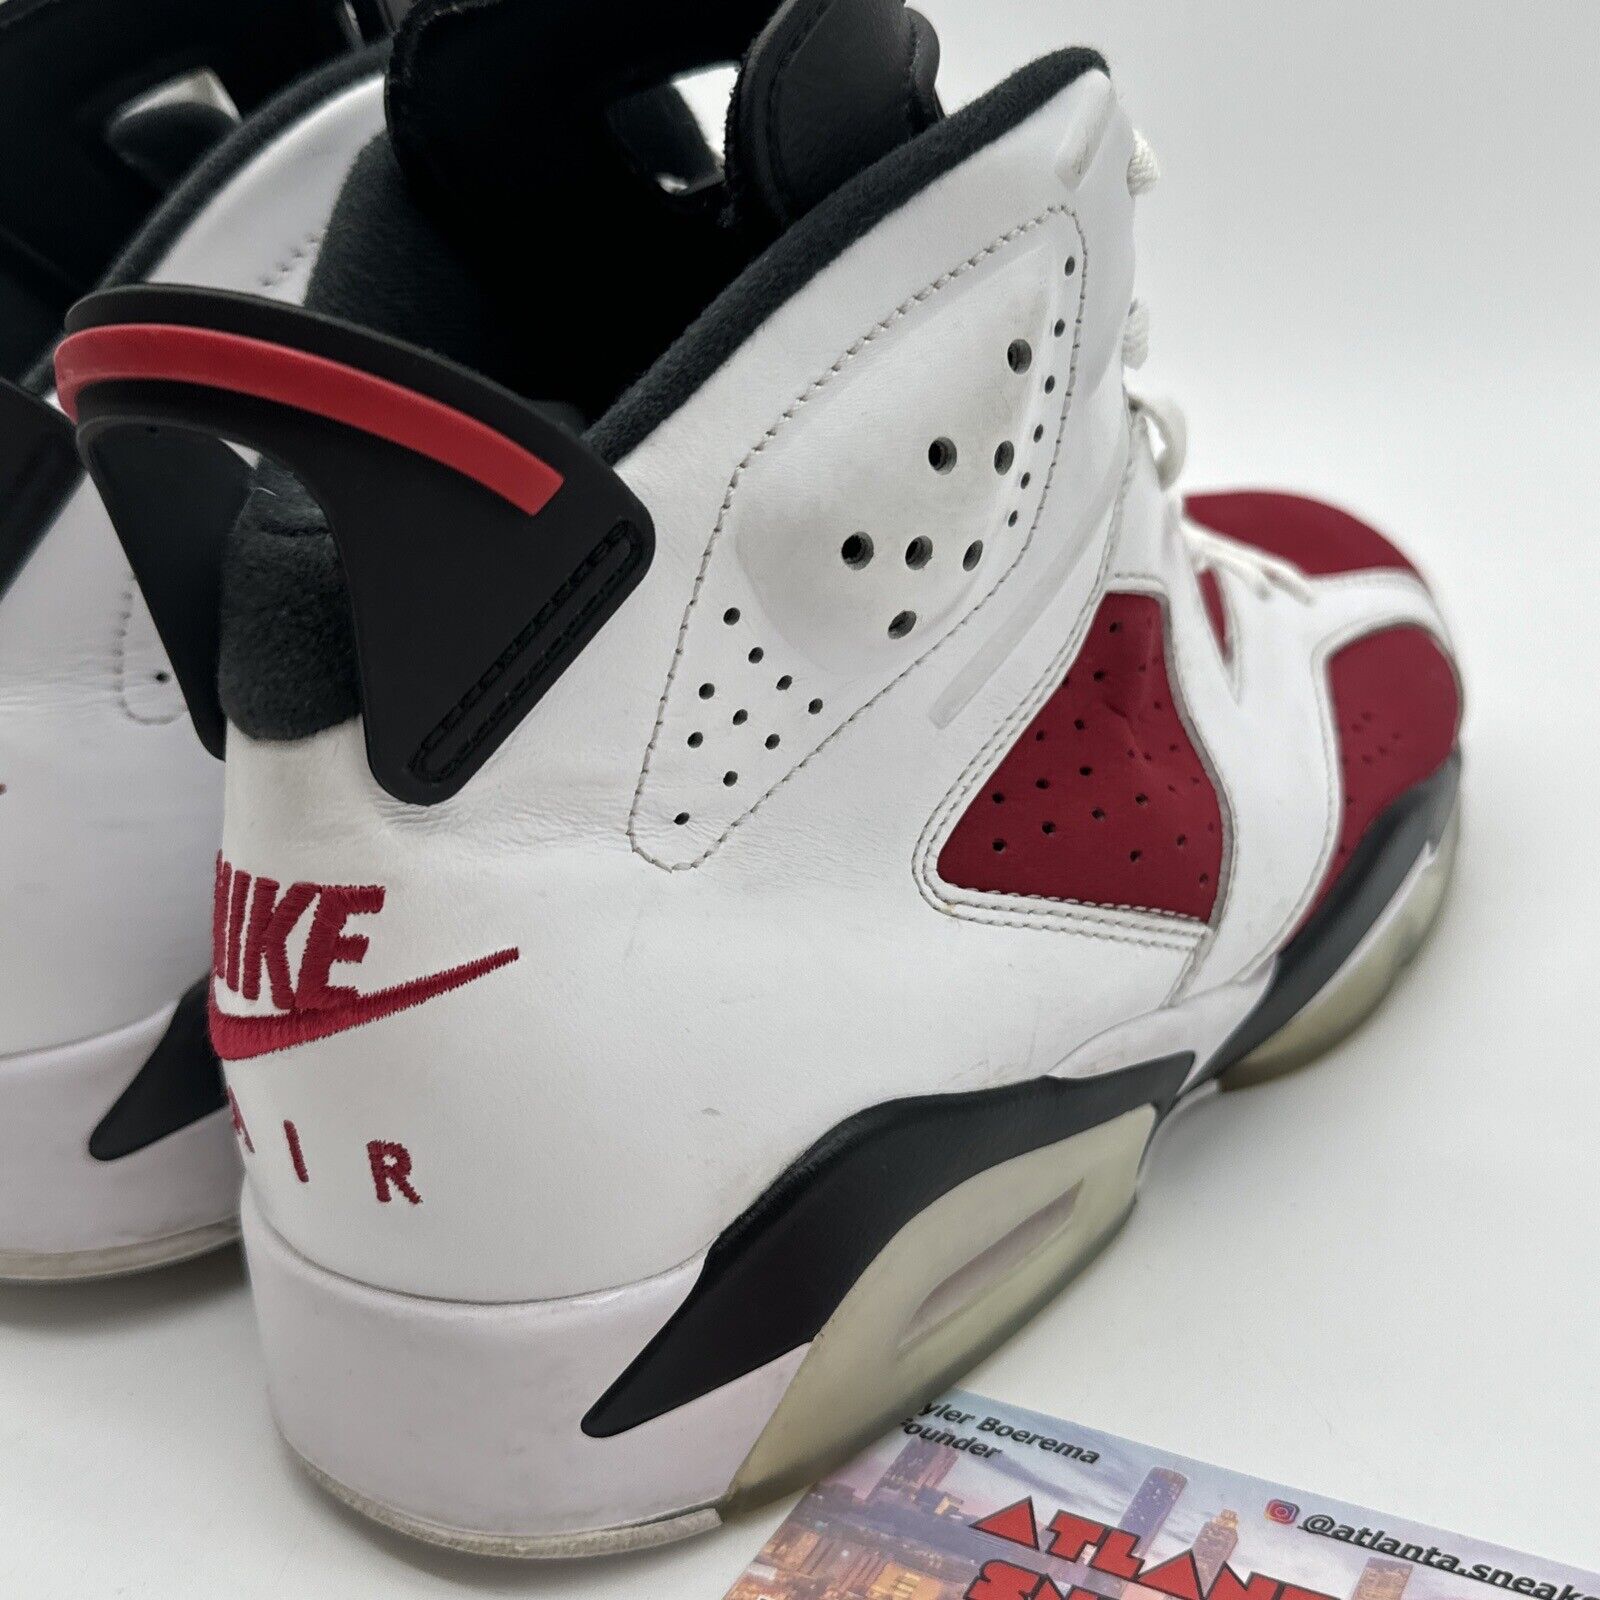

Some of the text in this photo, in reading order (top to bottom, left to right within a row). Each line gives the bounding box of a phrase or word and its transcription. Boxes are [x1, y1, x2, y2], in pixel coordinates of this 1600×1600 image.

[918, 1402, 1100, 1464] yler Boerema
[1298, 1513, 1600, 1600] @atlanta.sneak
